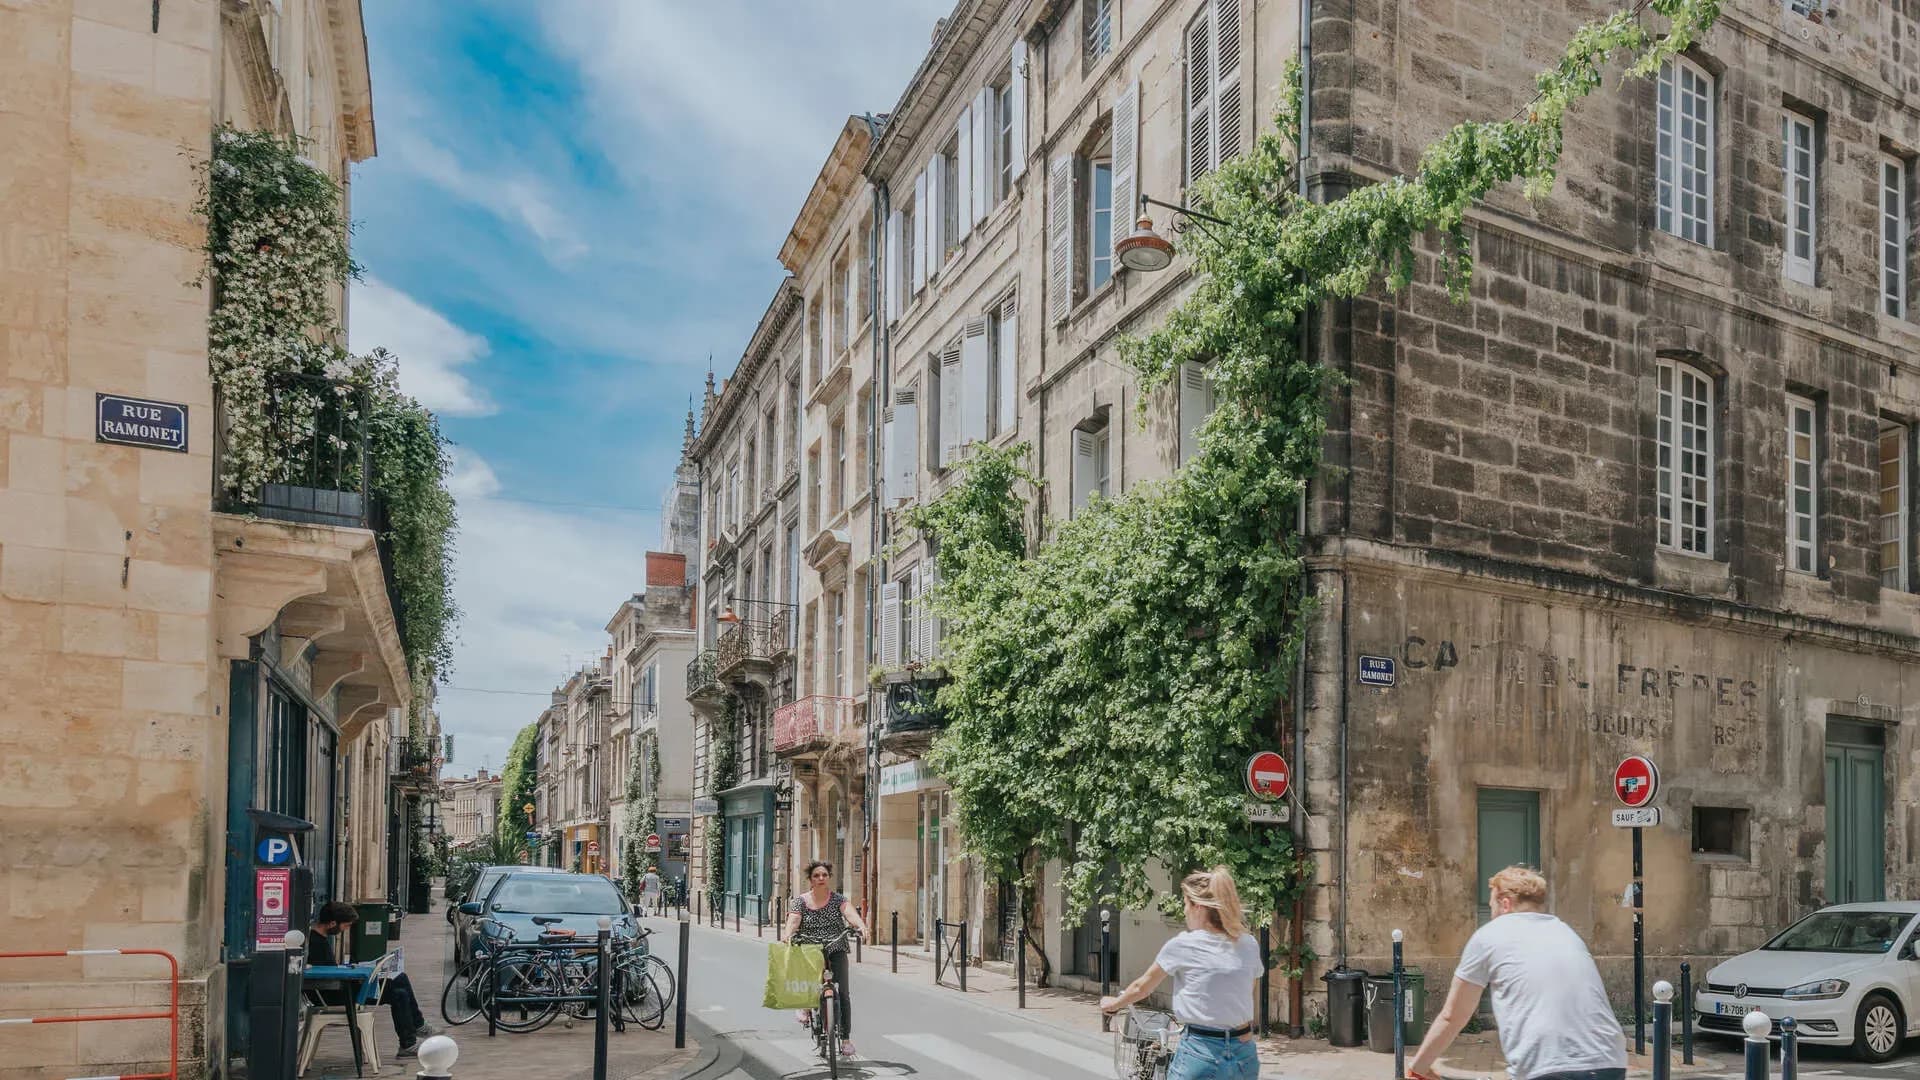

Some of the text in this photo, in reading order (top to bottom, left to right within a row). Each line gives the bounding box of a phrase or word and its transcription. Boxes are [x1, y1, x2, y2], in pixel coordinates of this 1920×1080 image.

[122, 404, 162, 421] RUE
[104, 420, 181, 442] RAMONET
[1369, 660, 1387, 670] RUE
[1362, 670, 1393, 682] RAMONET
[1247, 807, 1267, 817] SAUF
[1616, 813, 1635, 822] SAUF
[267, 838, 289, 863] P
